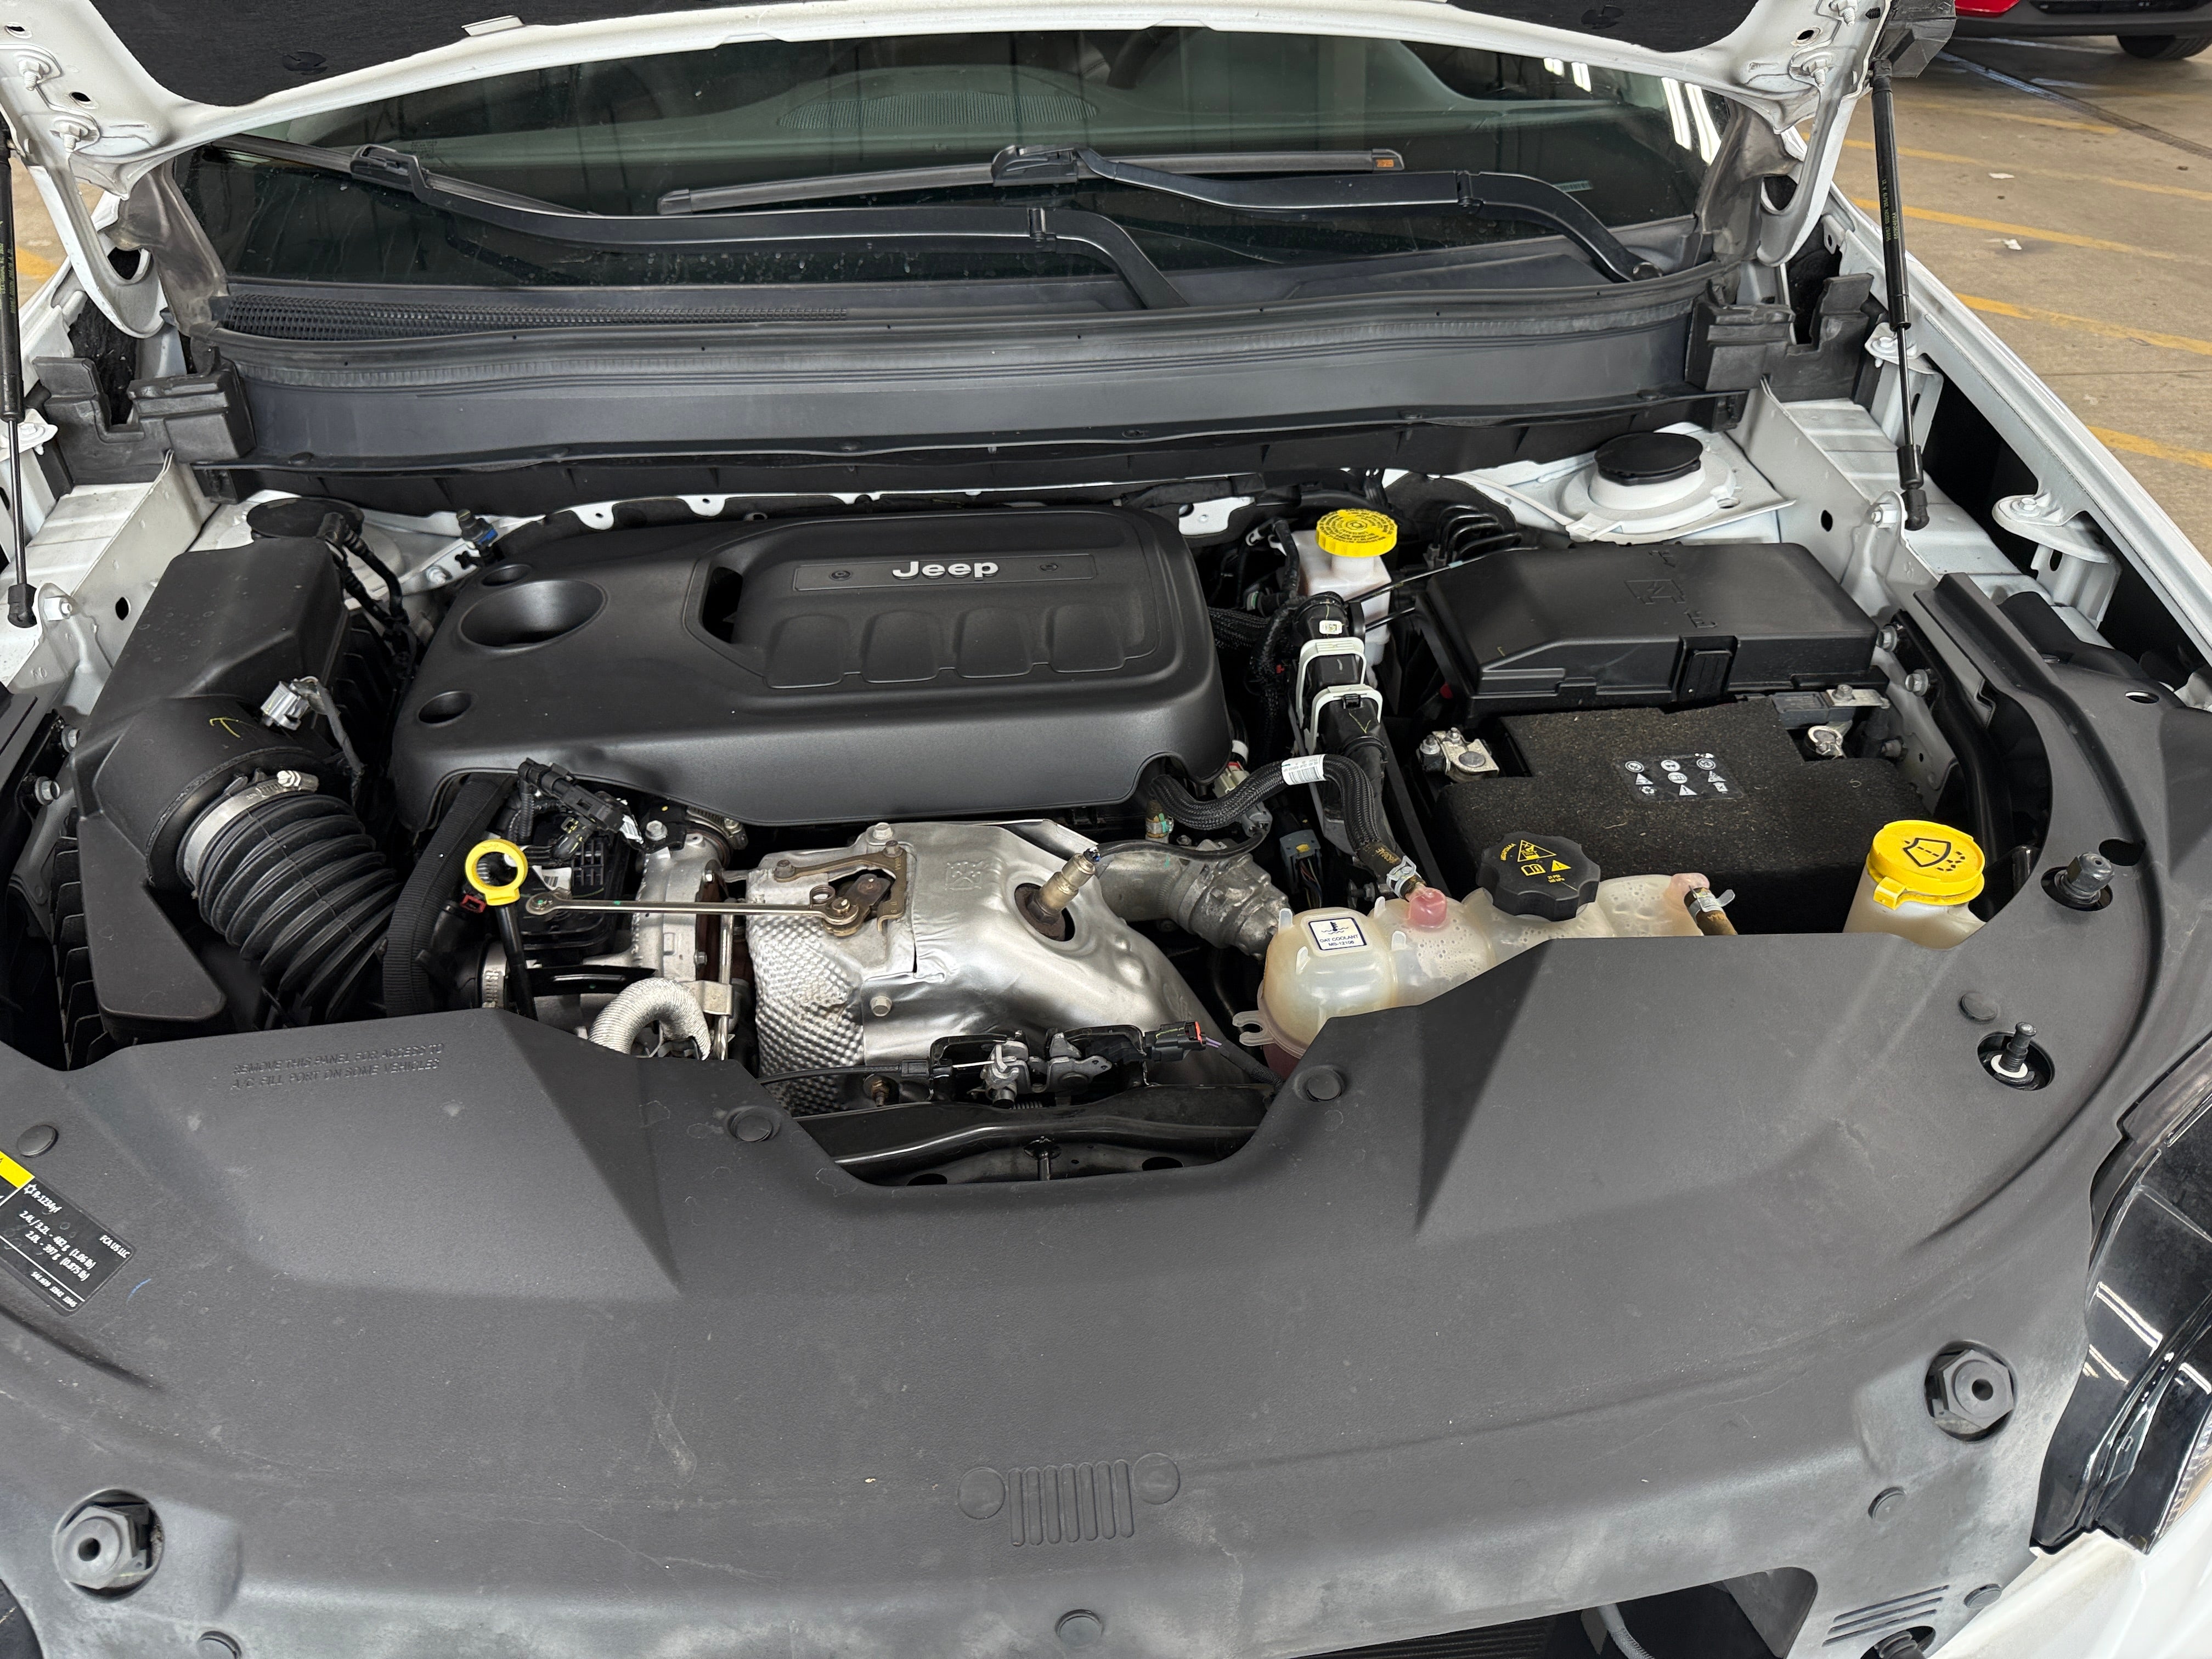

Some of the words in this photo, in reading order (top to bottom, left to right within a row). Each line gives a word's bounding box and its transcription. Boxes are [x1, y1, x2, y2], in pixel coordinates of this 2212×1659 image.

[892, 561, 998, 580] Jeep
[230, 1077, 255, 1091] A/C
[259, 1074, 284, 1087] FILL
[288, 1070, 320, 1084] PORT
[324, 1069, 342, 1081] ON
[345, 1064, 379, 1079] SOME
[383, 1058, 441, 1075] VEHICLES
[233, 1059, 282, 1075] REMOVE
[285, 1057, 312, 1070] THIS
[314, 1053, 350, 1067] PANEL
[353, 1049, 379, 1063] FOR
[381, 1045, 426, 1059] ACCESS
[428, 1042, 445, 1055] TO
[31, 1189, 63, 1214] R-1234yf
[25, 1230, 41, 1244] 2.0L
[42, 1244, 59, 1256] 397
[59, 1257, 82, 1274] (0.875
[77, 1269, 91, 1282] lb)
[53, 1235, 67, 1248] 482
[69, 1248, 88, 1263] (1.06
[84, 1257, 97, 1270] lb)
[99, 1234, 112, 1246] FCA
[118, 1247, 131, 1259] LLC
